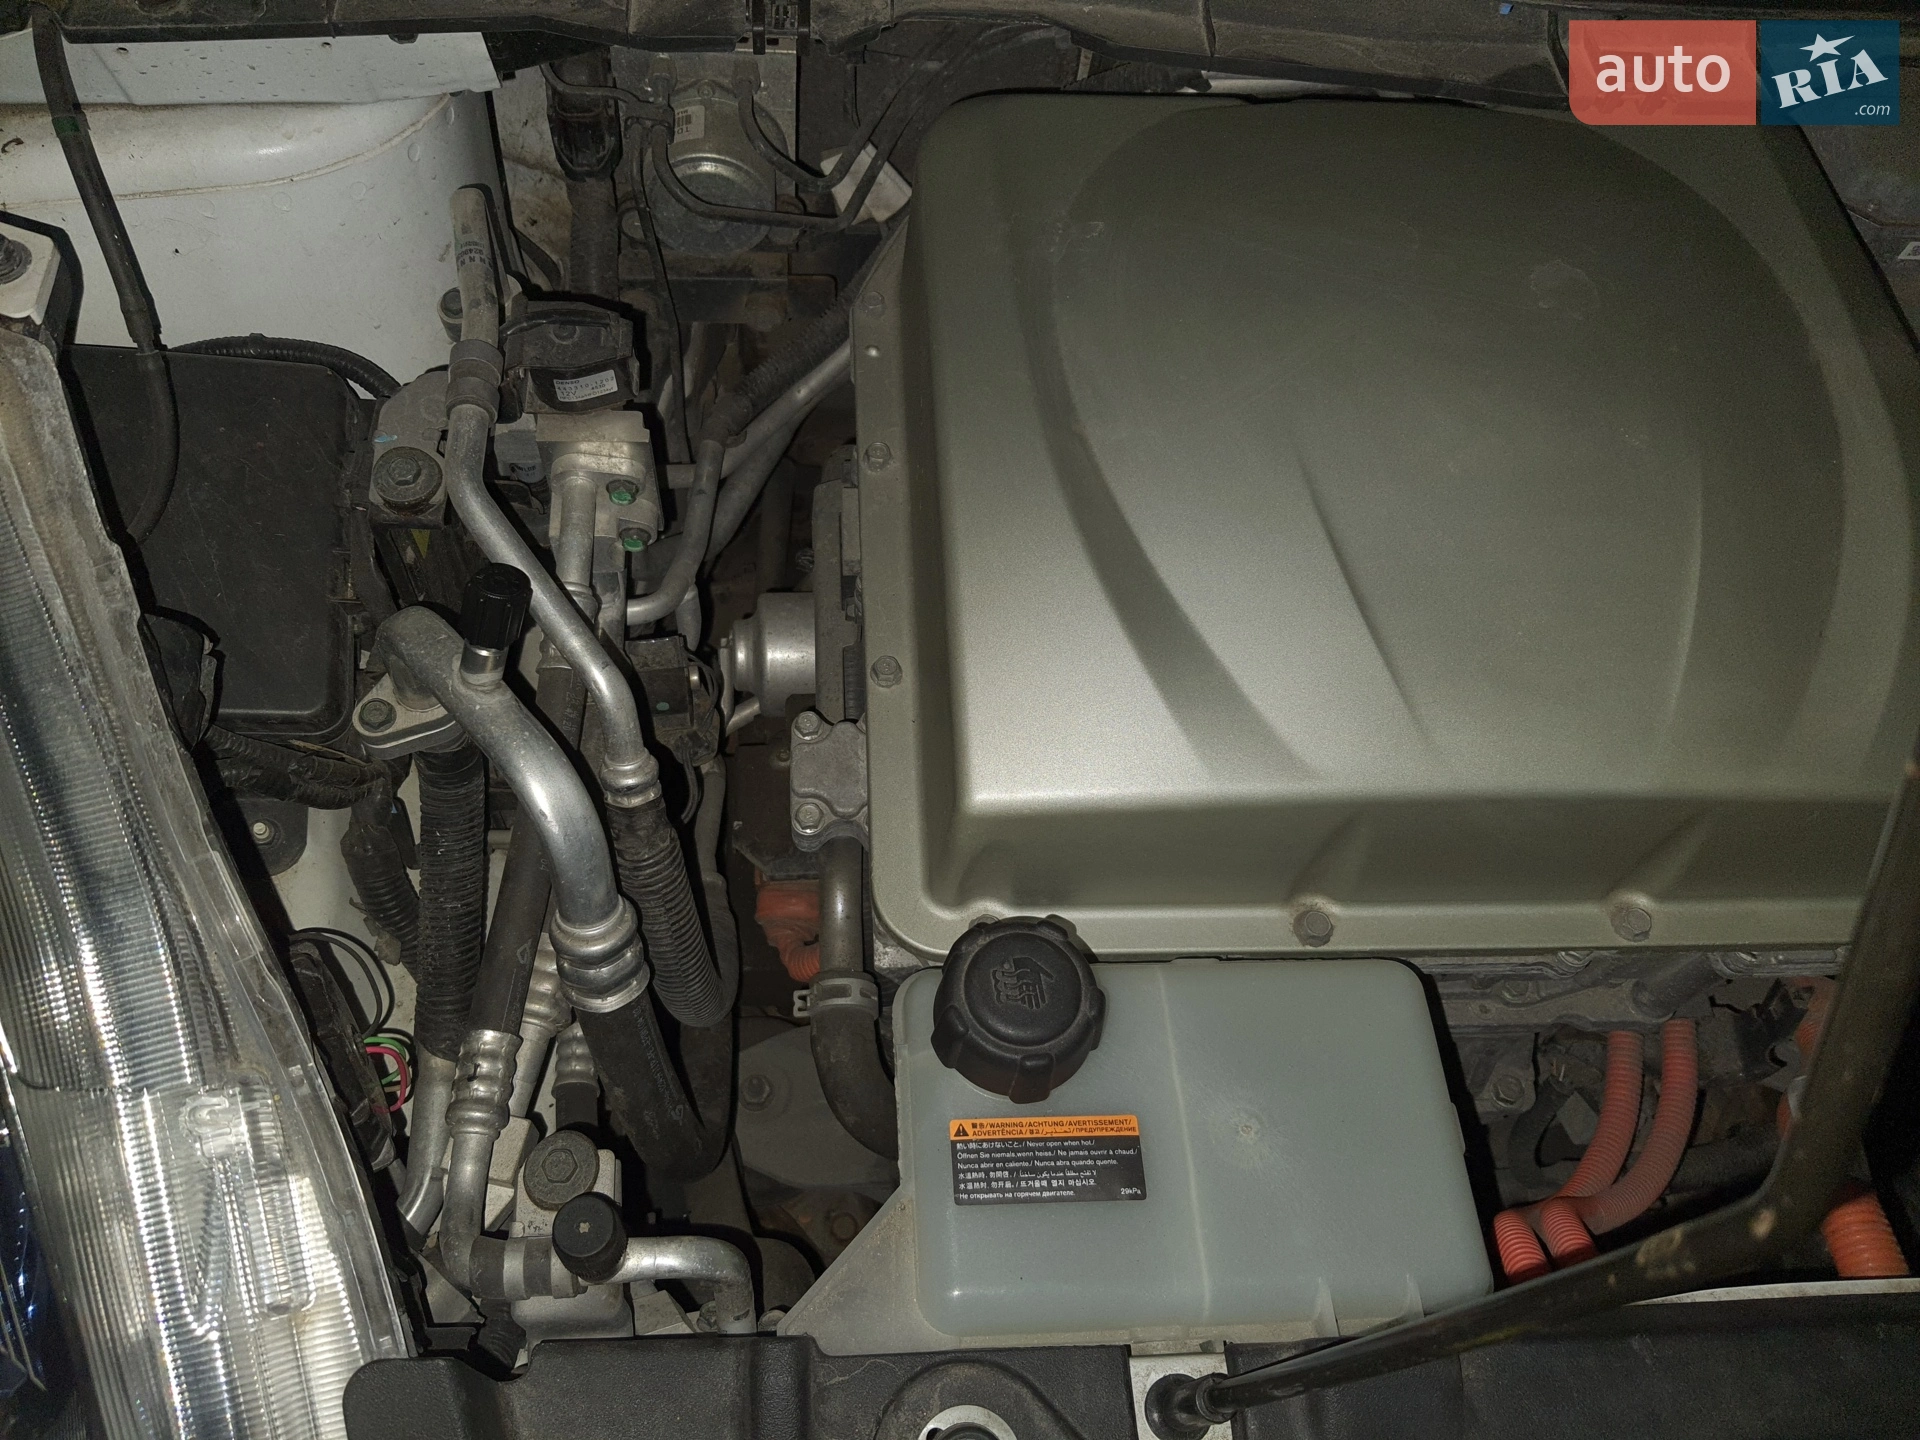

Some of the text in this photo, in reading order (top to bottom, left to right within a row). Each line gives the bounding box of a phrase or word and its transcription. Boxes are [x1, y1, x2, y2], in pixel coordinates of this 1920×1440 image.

[1068, 1149, 1088, 1157] jamais
[1071, 1159, 1095, 1167] quando
[1095, 1158, 1119, 1166] quente.
[969, 1192, 1003, 1200] открывать
[1013, 1190, 1041, 1198] горячем
[1120, 1187, 1142, 1195] 29kPa
